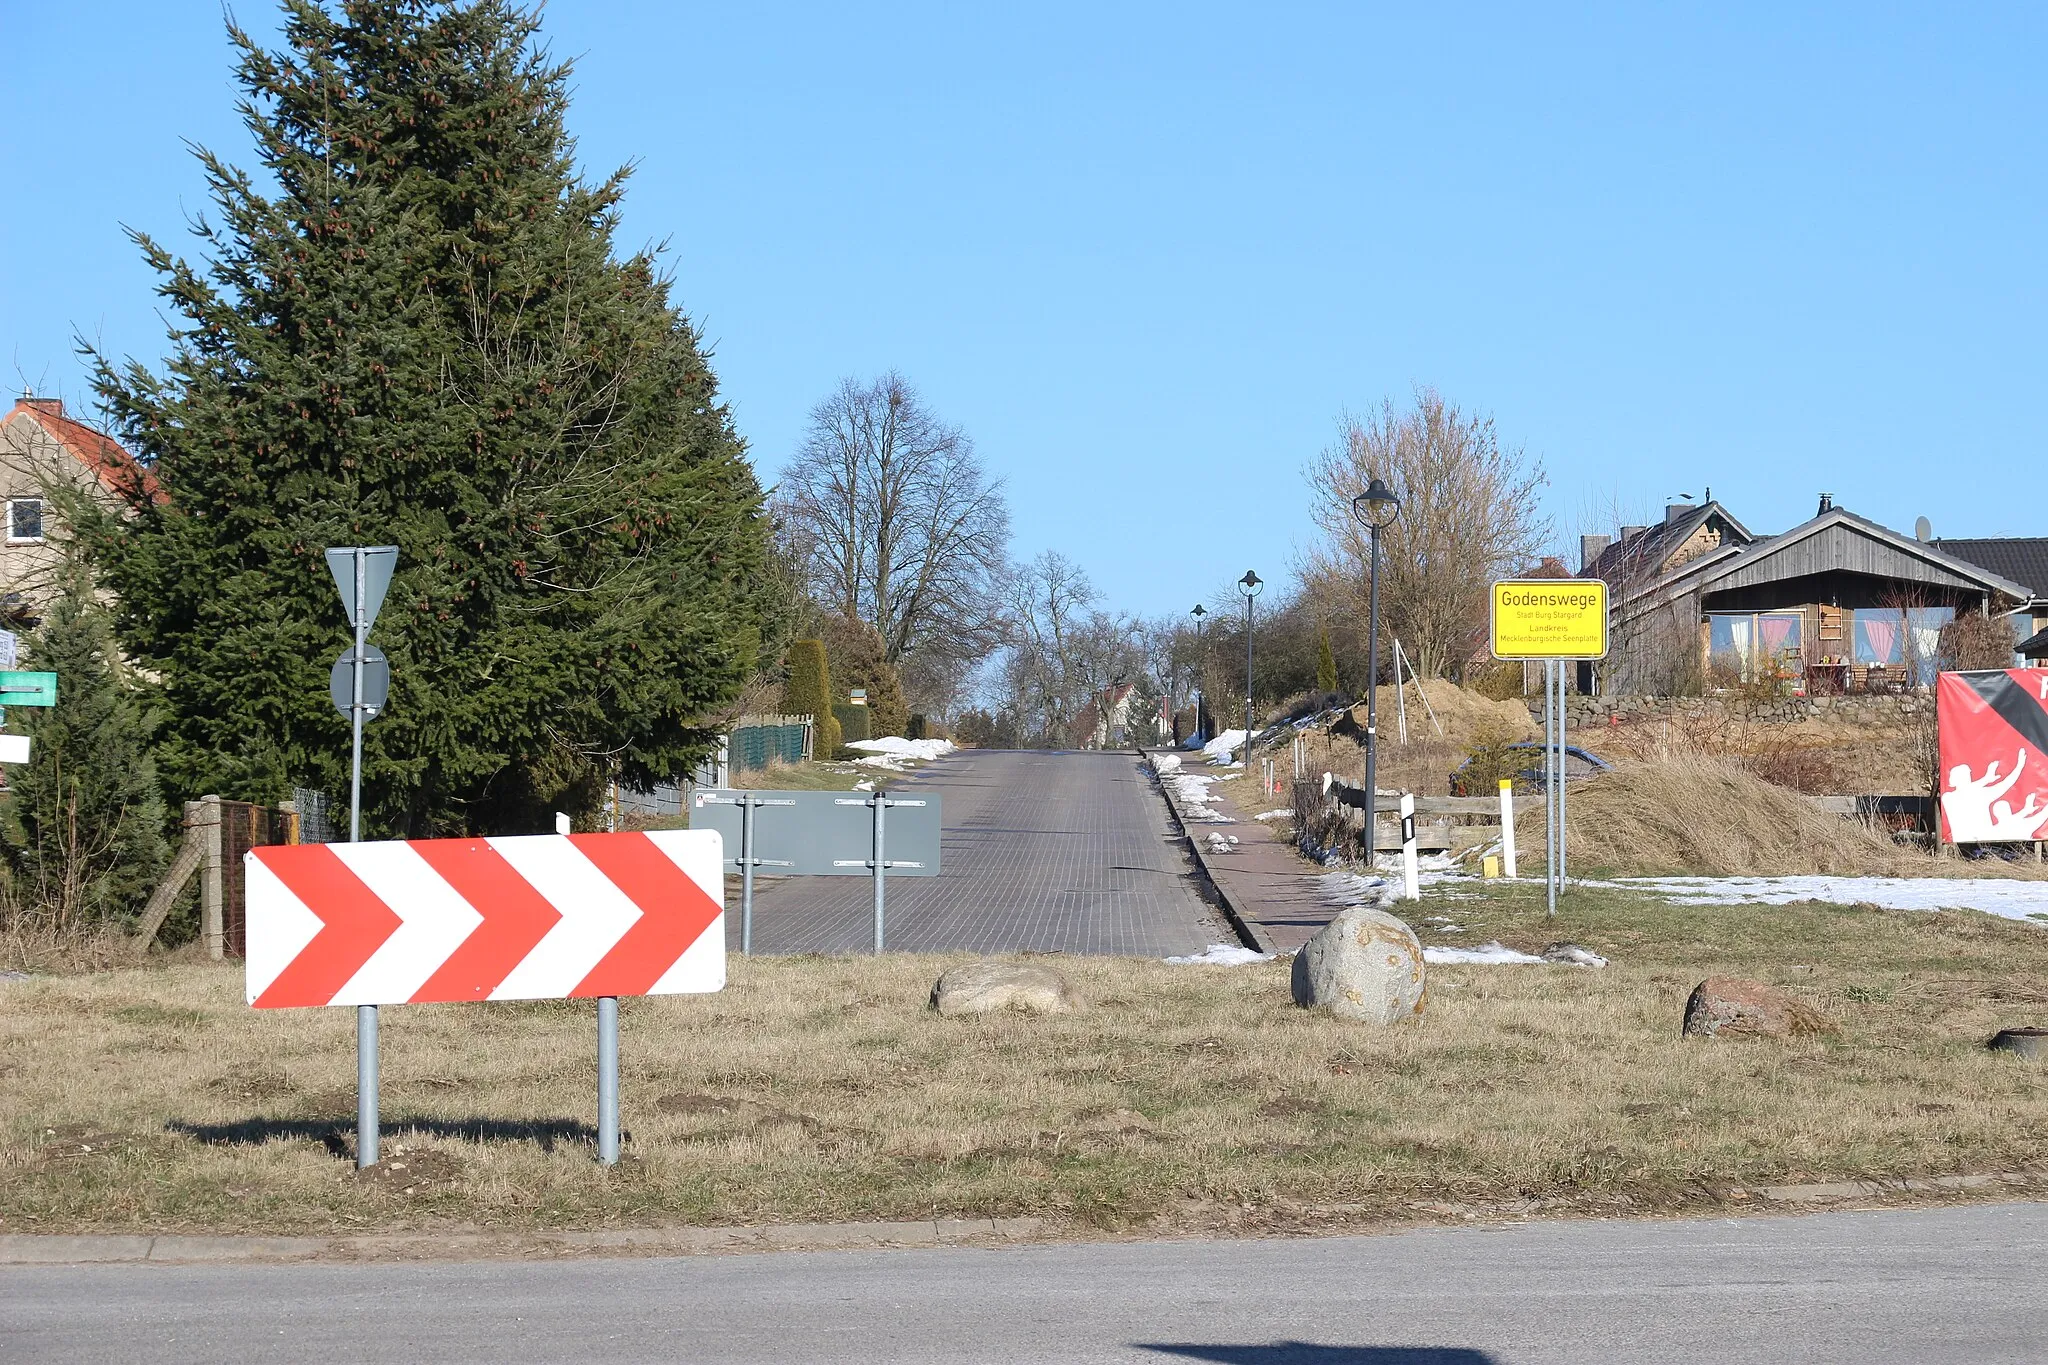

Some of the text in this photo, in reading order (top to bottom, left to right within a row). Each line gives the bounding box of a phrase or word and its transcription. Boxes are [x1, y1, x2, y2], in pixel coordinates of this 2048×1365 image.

[1502, 591, 1596, 610] Godenswege
[1517, 611, 1583, 620] Stadt Burg Stargard
[1500, 635, 1598, 643] Mecklenburgische Seenplatte
